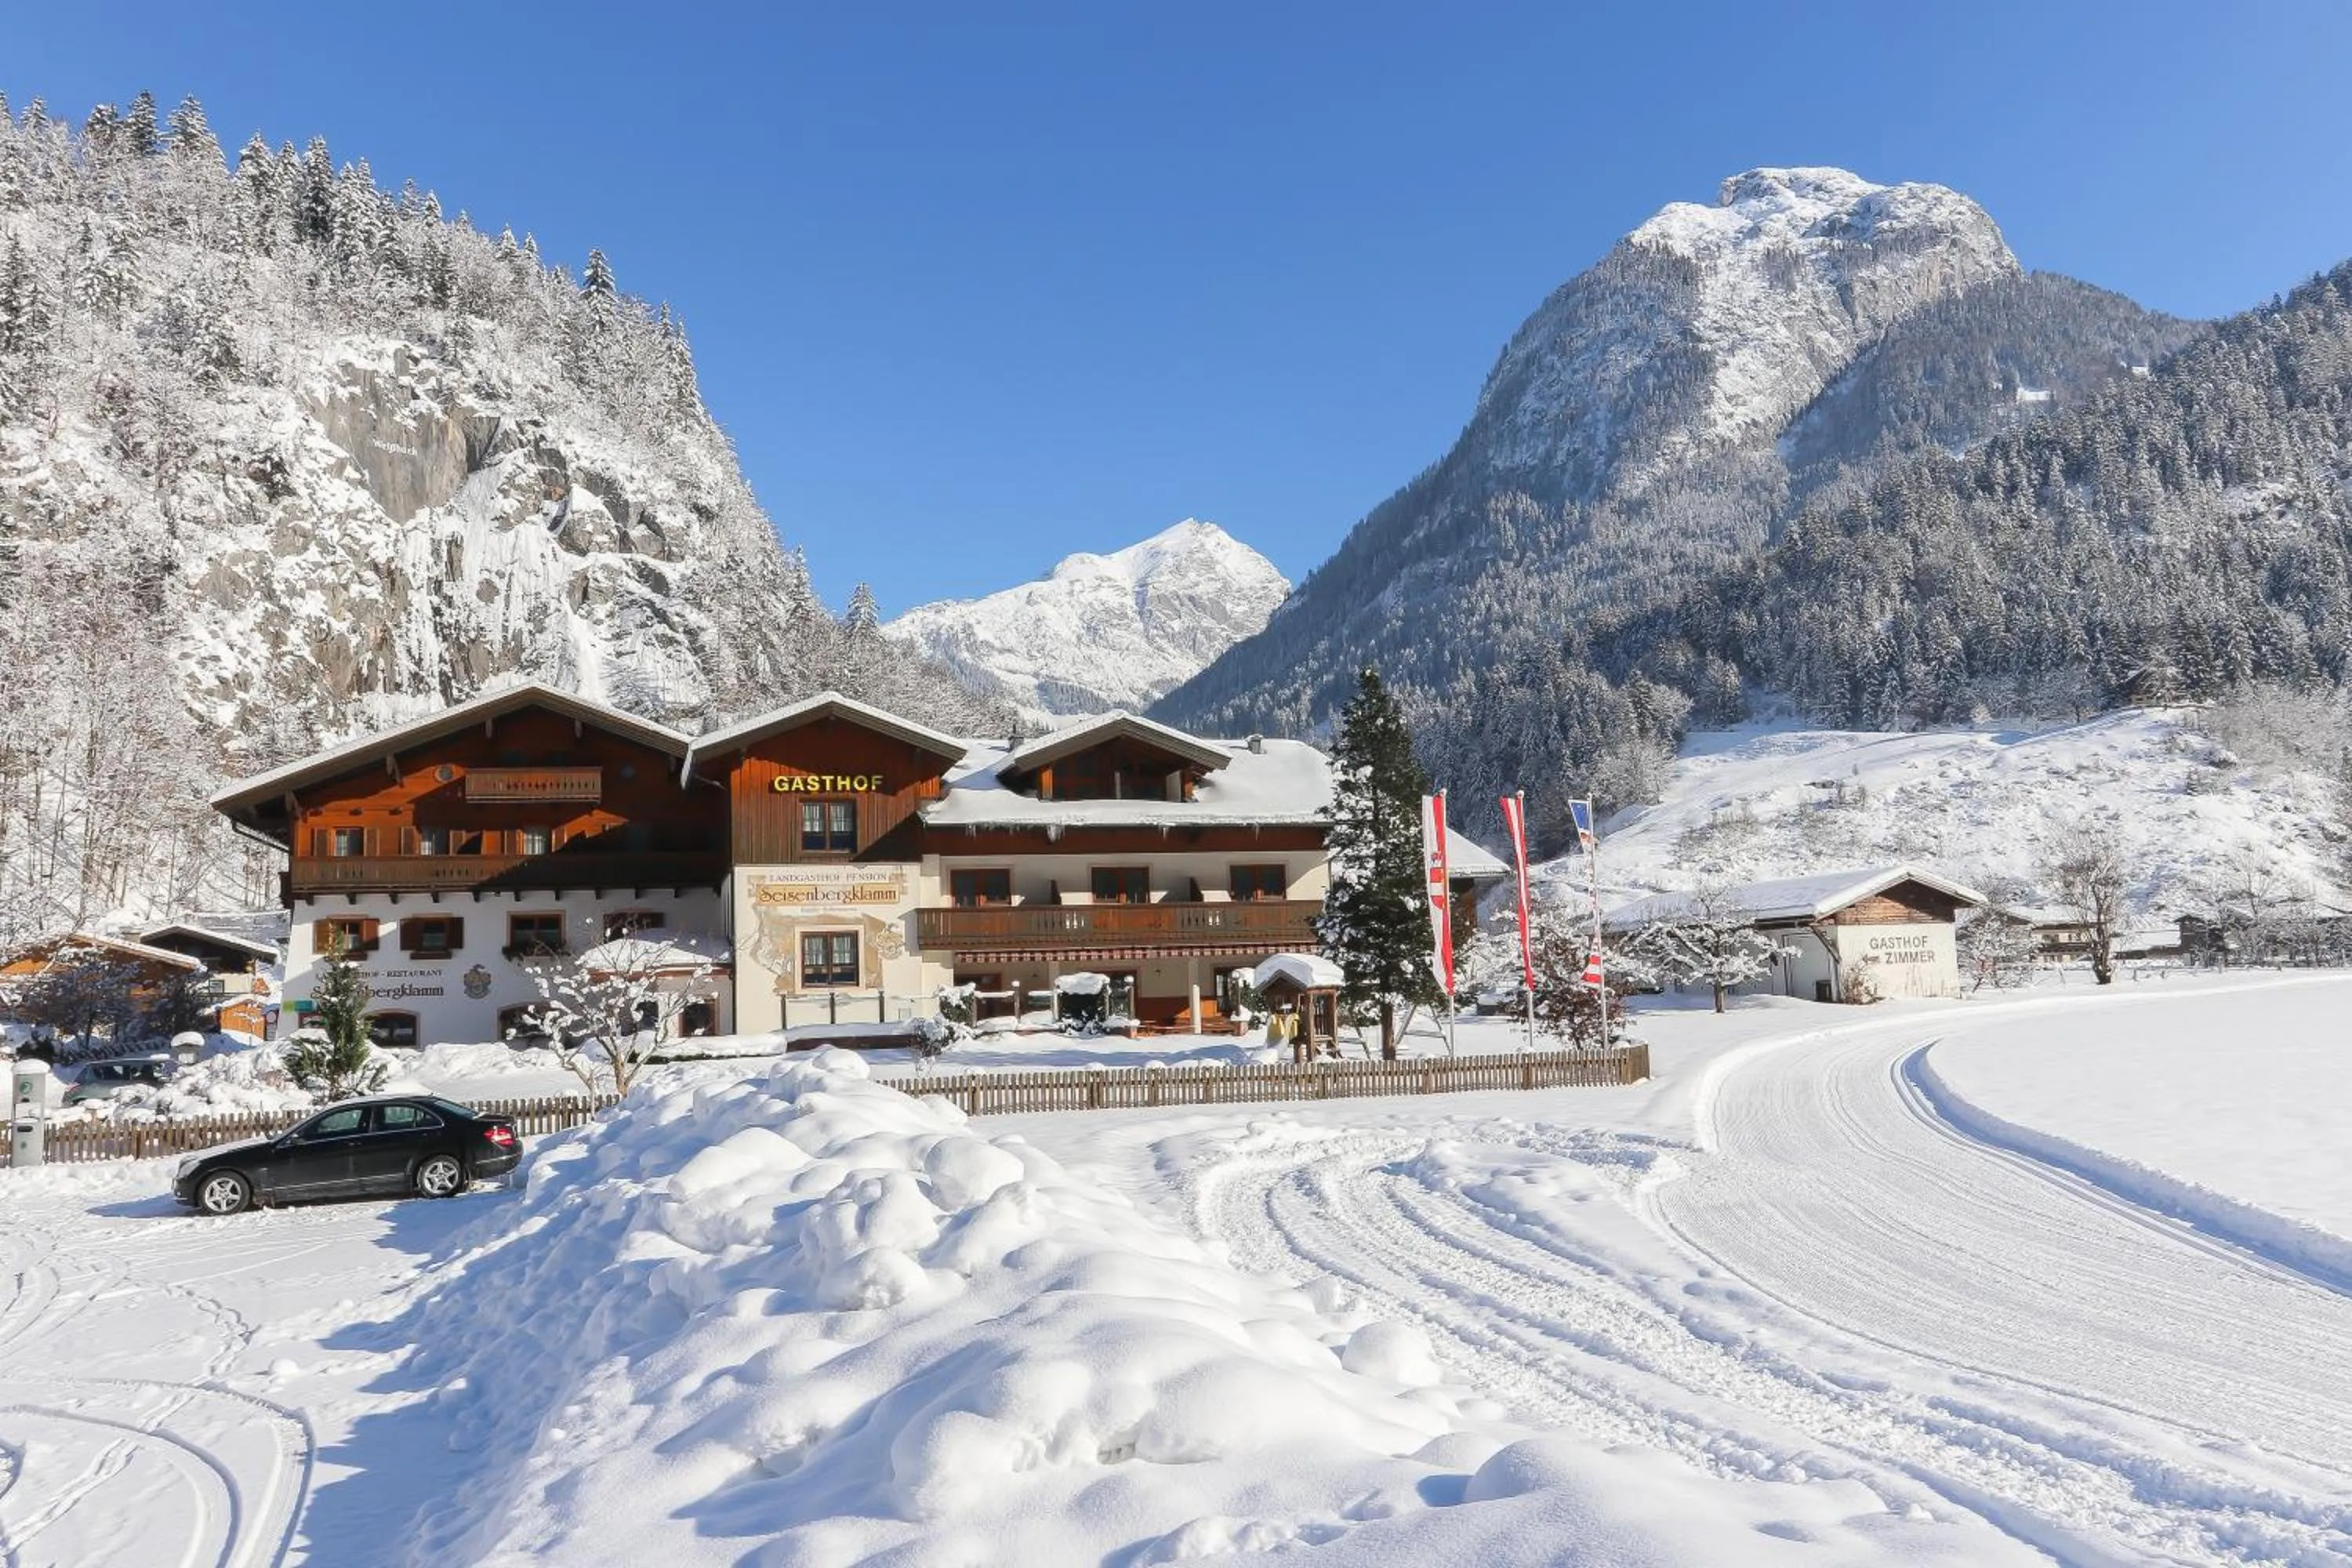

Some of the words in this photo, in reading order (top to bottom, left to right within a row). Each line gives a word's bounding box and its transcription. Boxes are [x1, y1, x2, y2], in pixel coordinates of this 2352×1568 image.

[774, 775, 884, 791] GASTHOF
[768, 873, 841, 884] LANDGASTHOF
[846, 873, 887, 883] PENSION
[758, 884, 897, 903] Seisenbergklamm
[1869, 935, 1929, 950] GASTHOF
[1884, 949, 1936, 965] ZIMMER
[387, 968, 442, 978] RESTAURANT
